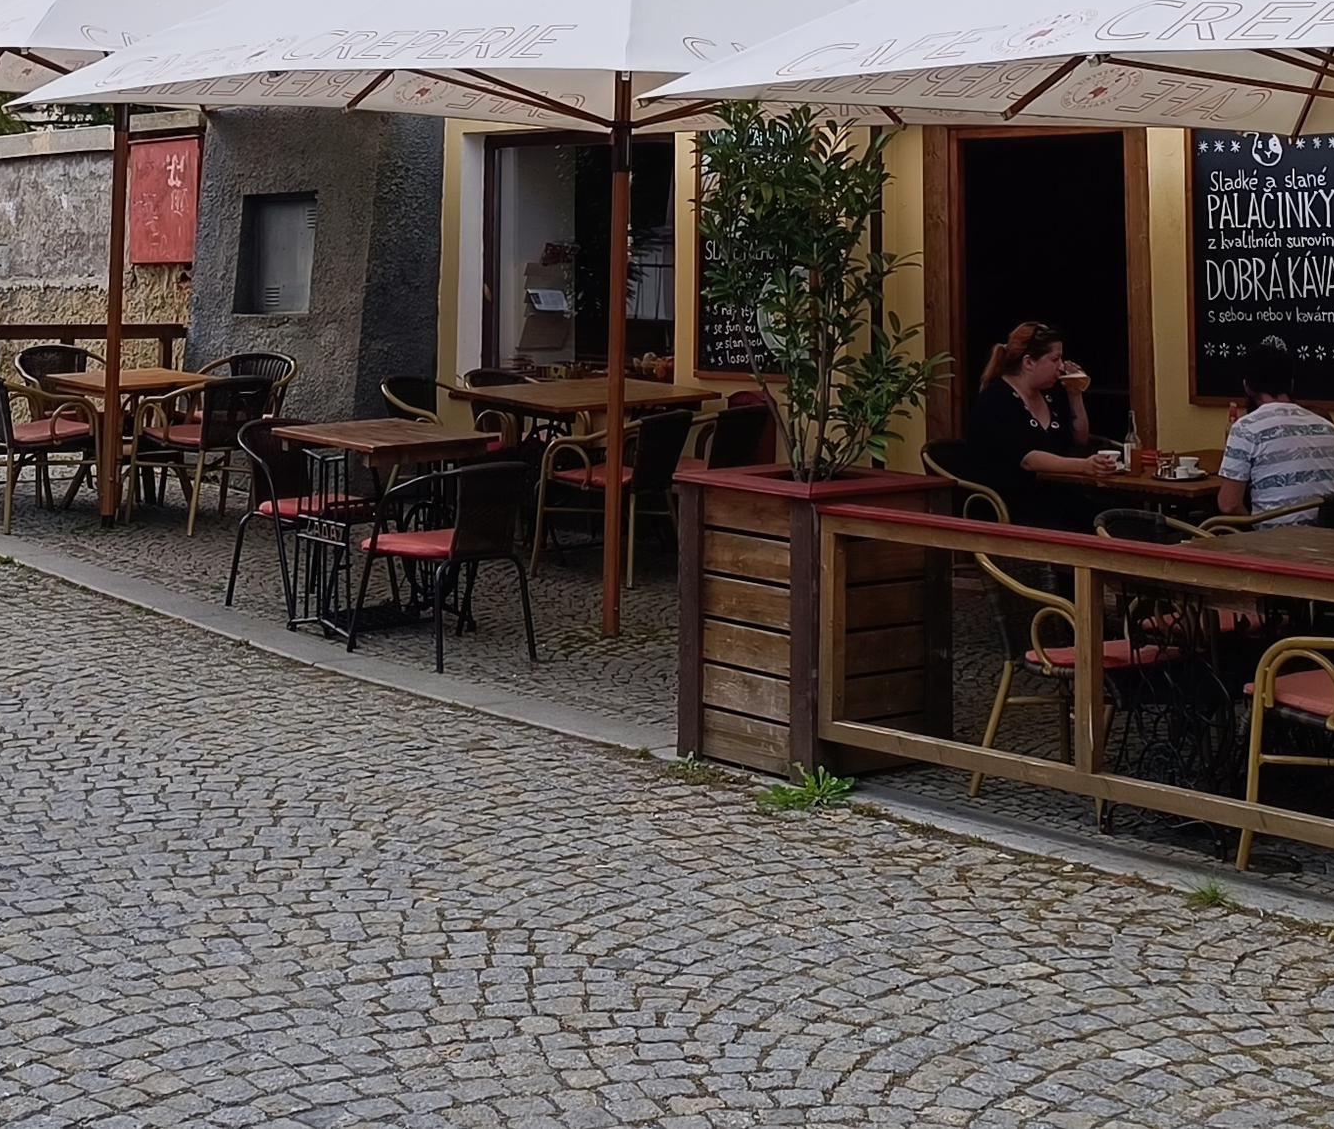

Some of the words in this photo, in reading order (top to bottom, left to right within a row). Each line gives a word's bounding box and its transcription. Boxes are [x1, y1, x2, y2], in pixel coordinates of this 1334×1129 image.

[283, 23, 577, 61] CREPERIE
[1210, 170, 1258, 192] Sladké
[1265, 175, 1277, 190] a
[1284, 167, 1327, 188] slané
[1208, 238, 1216, 250] z
[1221, 231, 1282, 249] kvalitních
[1286, 232, 1334, 248] surovin
[1206, 252, 1283, 301] DOBRÁ
[1219, 308, 1252, 323] sebou
[1256, 307, 1283, 322] nebo
[1285, 311, 1292, 321] v
[726, 350, 765, 365] lososm
